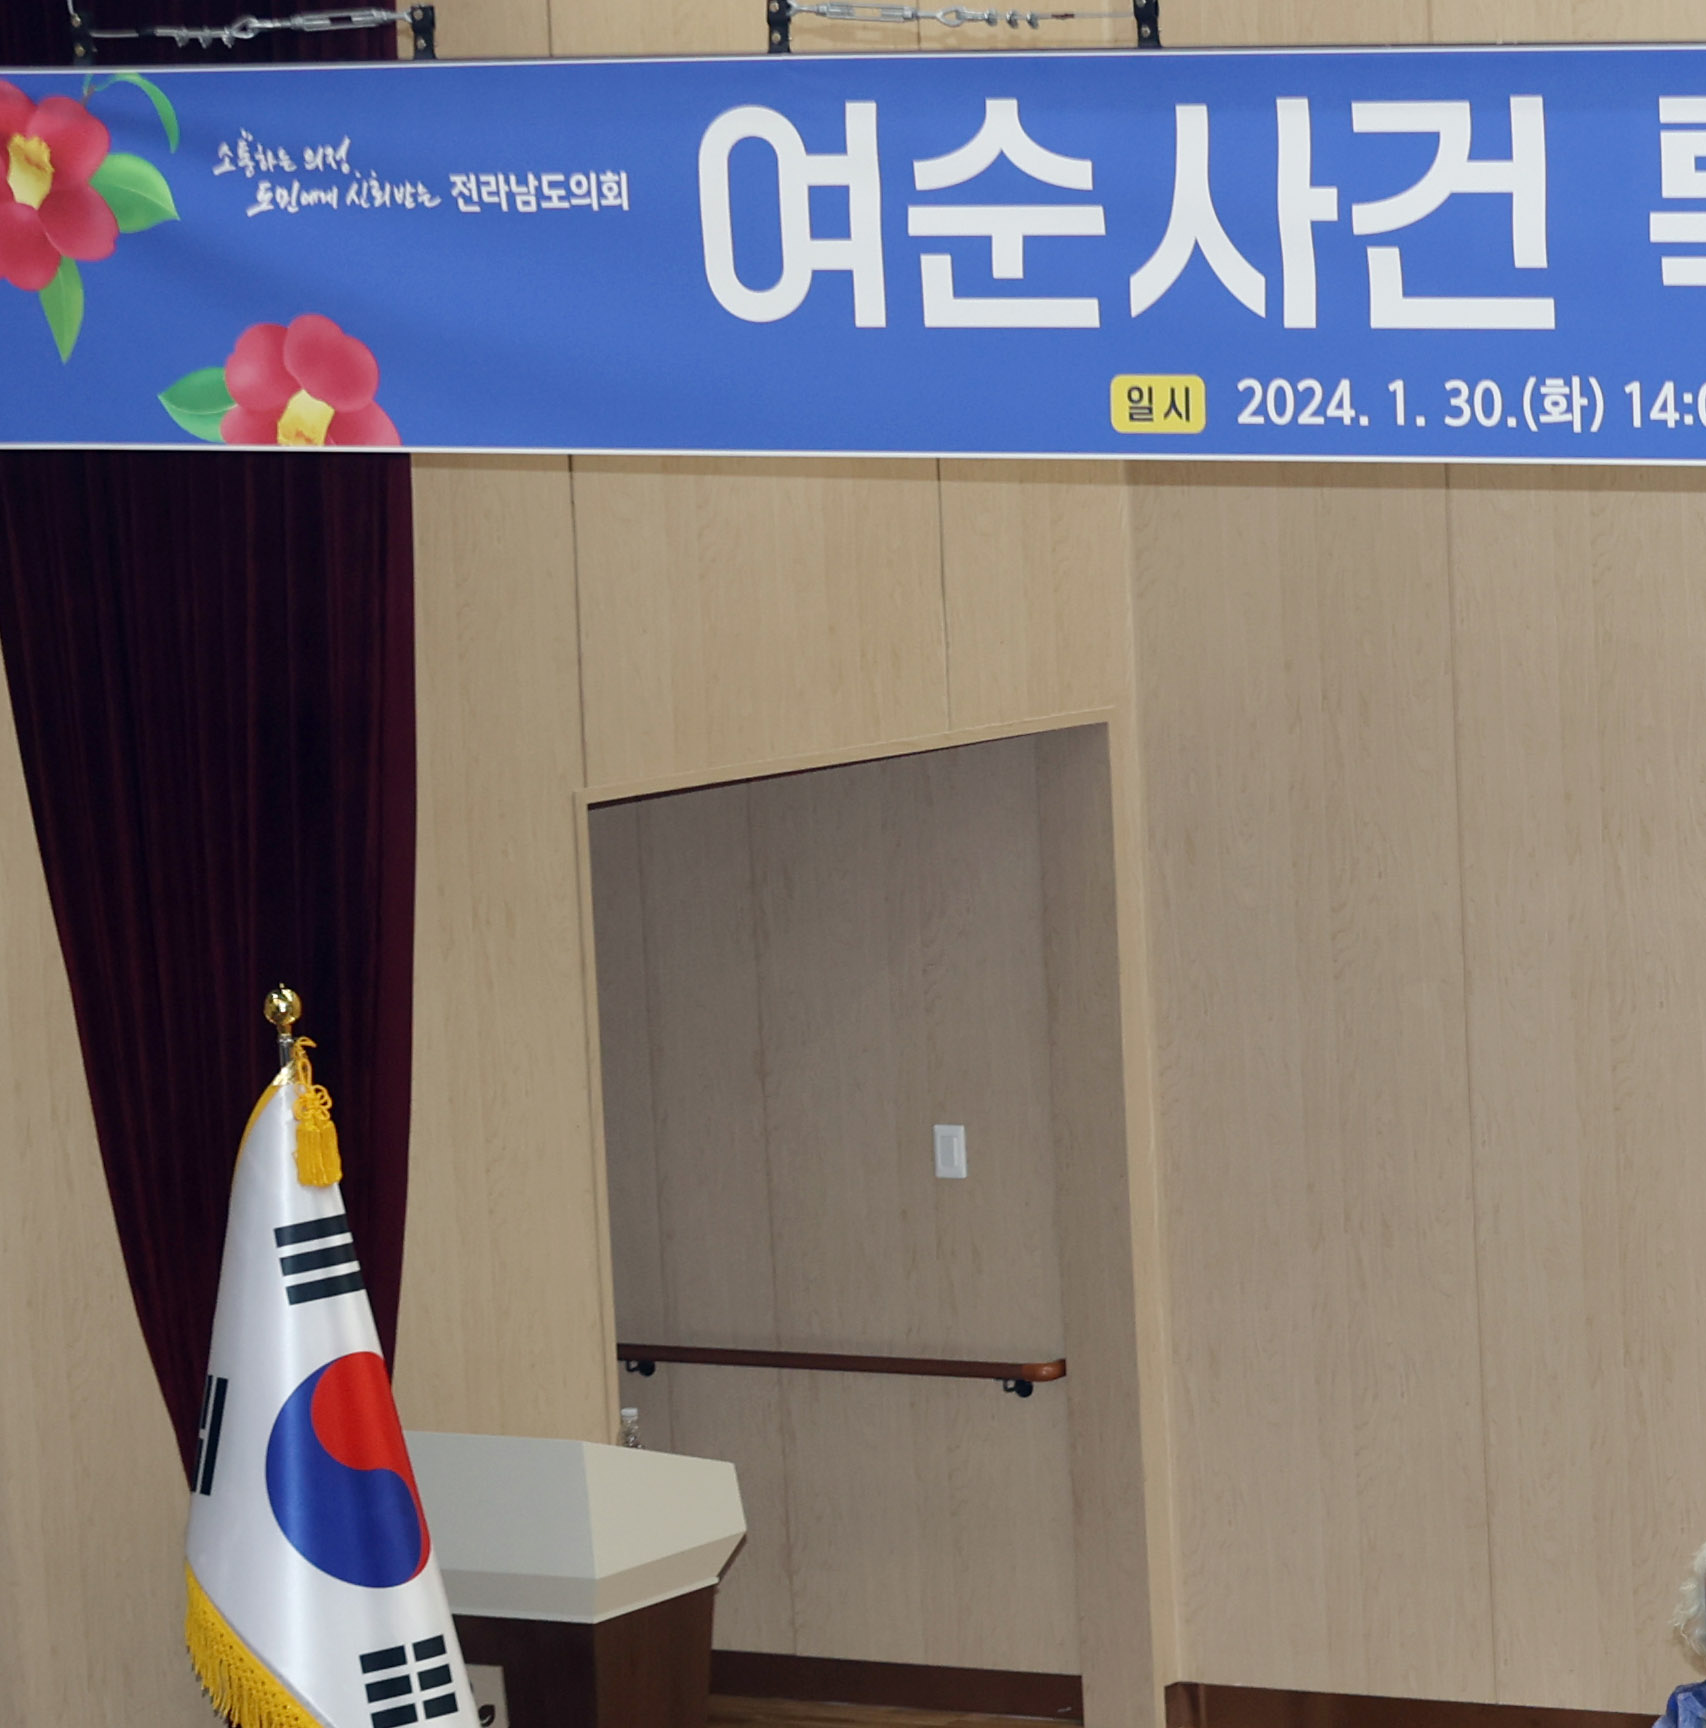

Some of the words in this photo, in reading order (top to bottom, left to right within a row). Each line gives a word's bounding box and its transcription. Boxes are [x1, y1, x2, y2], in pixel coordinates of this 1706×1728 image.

[449, 170, 630, 213] 전라남도의회
[699, 96, 1556, 330] 여순사건
[1127, 386, 1190, 422] 일시
[1237, 378, 1370, 427] 2024.
[1388, 379, 1426, 427] 1.
[1444, 375, 1604, 434] 30.(화)
